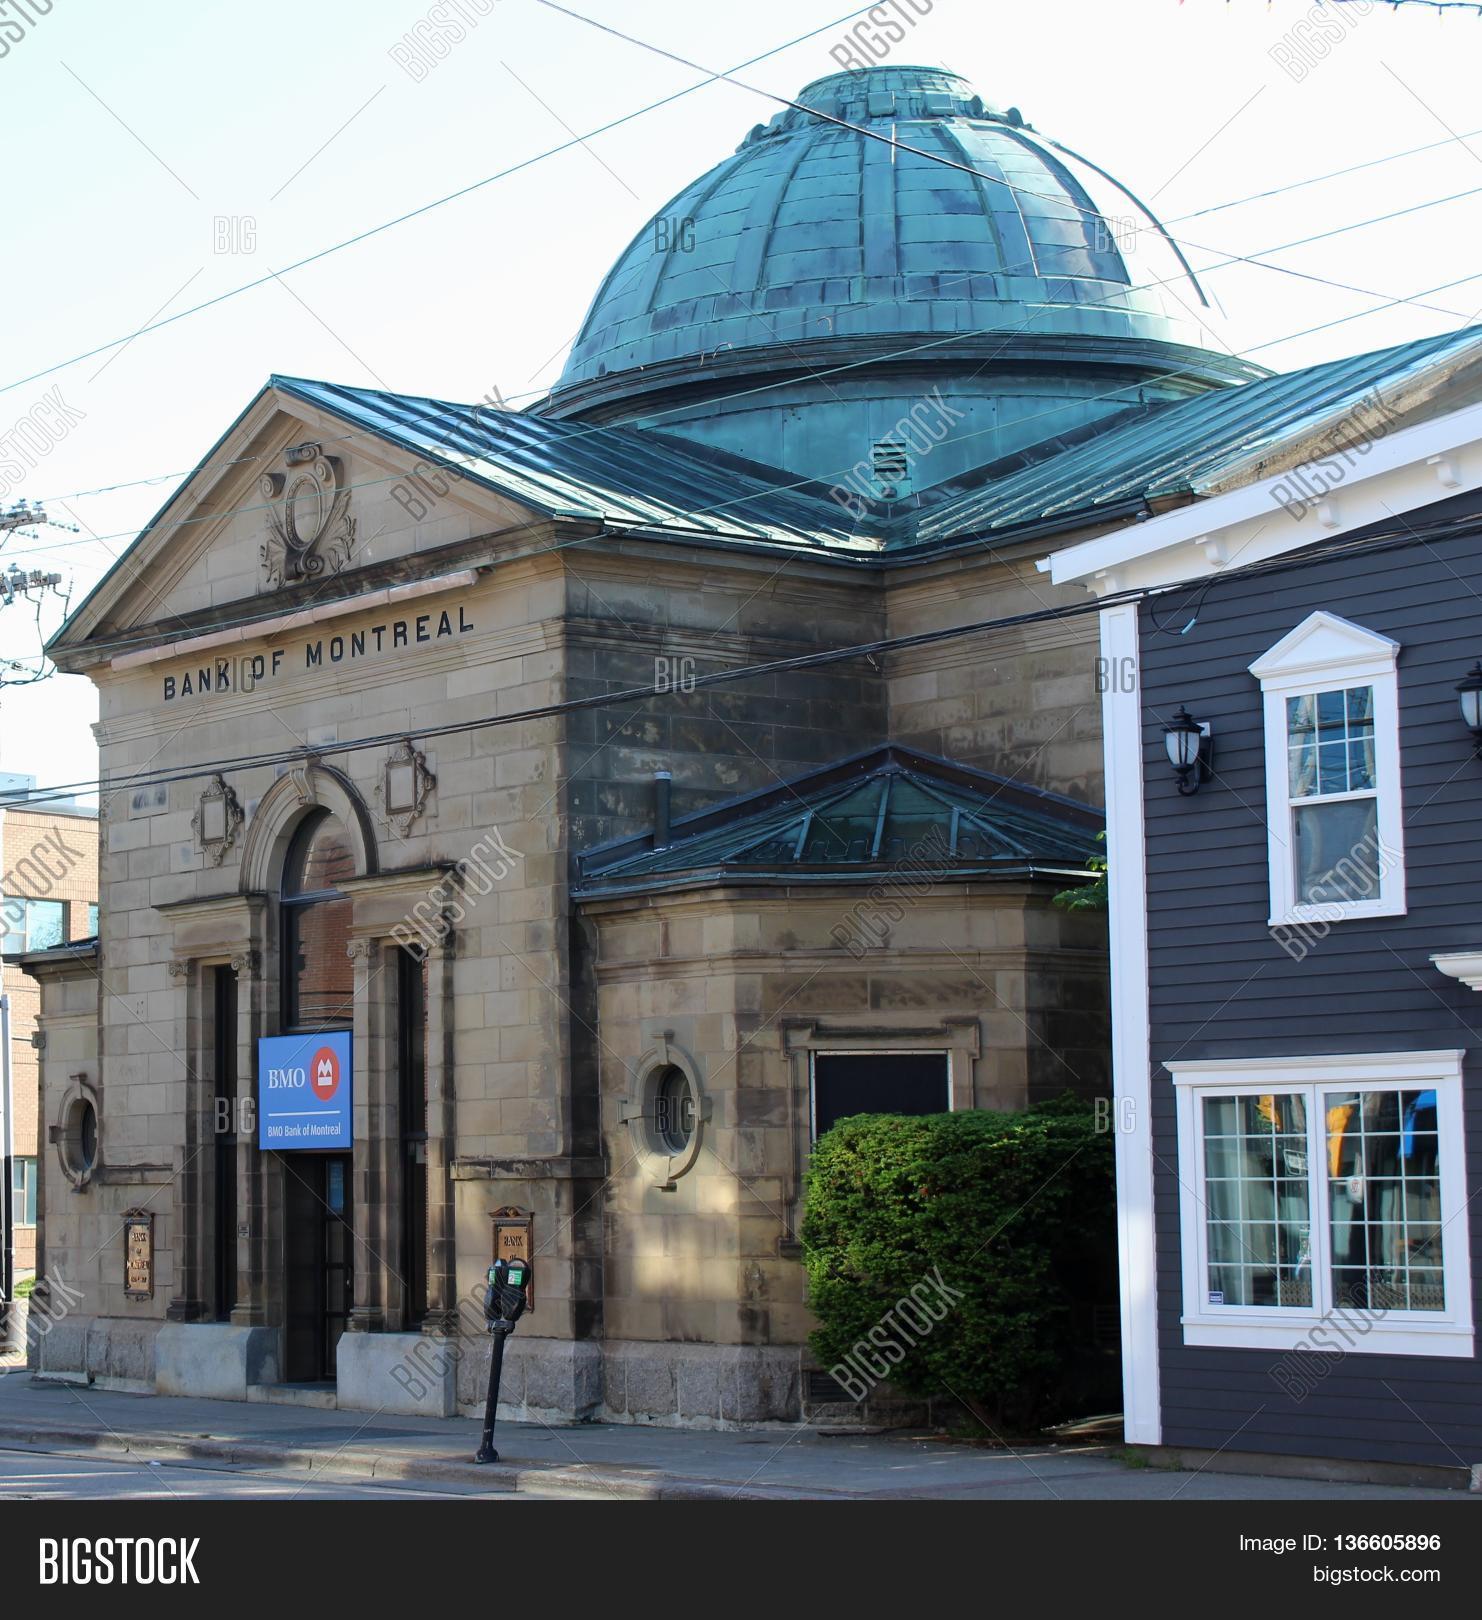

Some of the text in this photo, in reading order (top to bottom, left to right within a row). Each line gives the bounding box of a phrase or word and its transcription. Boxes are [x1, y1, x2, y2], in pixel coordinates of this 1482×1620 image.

[164, 606, 474, 700] BANK OF MONTREAL
[268, 1068, 306, 1089] BMO
[268, 1122, 341, 1137] BMO Bank of Montreal
